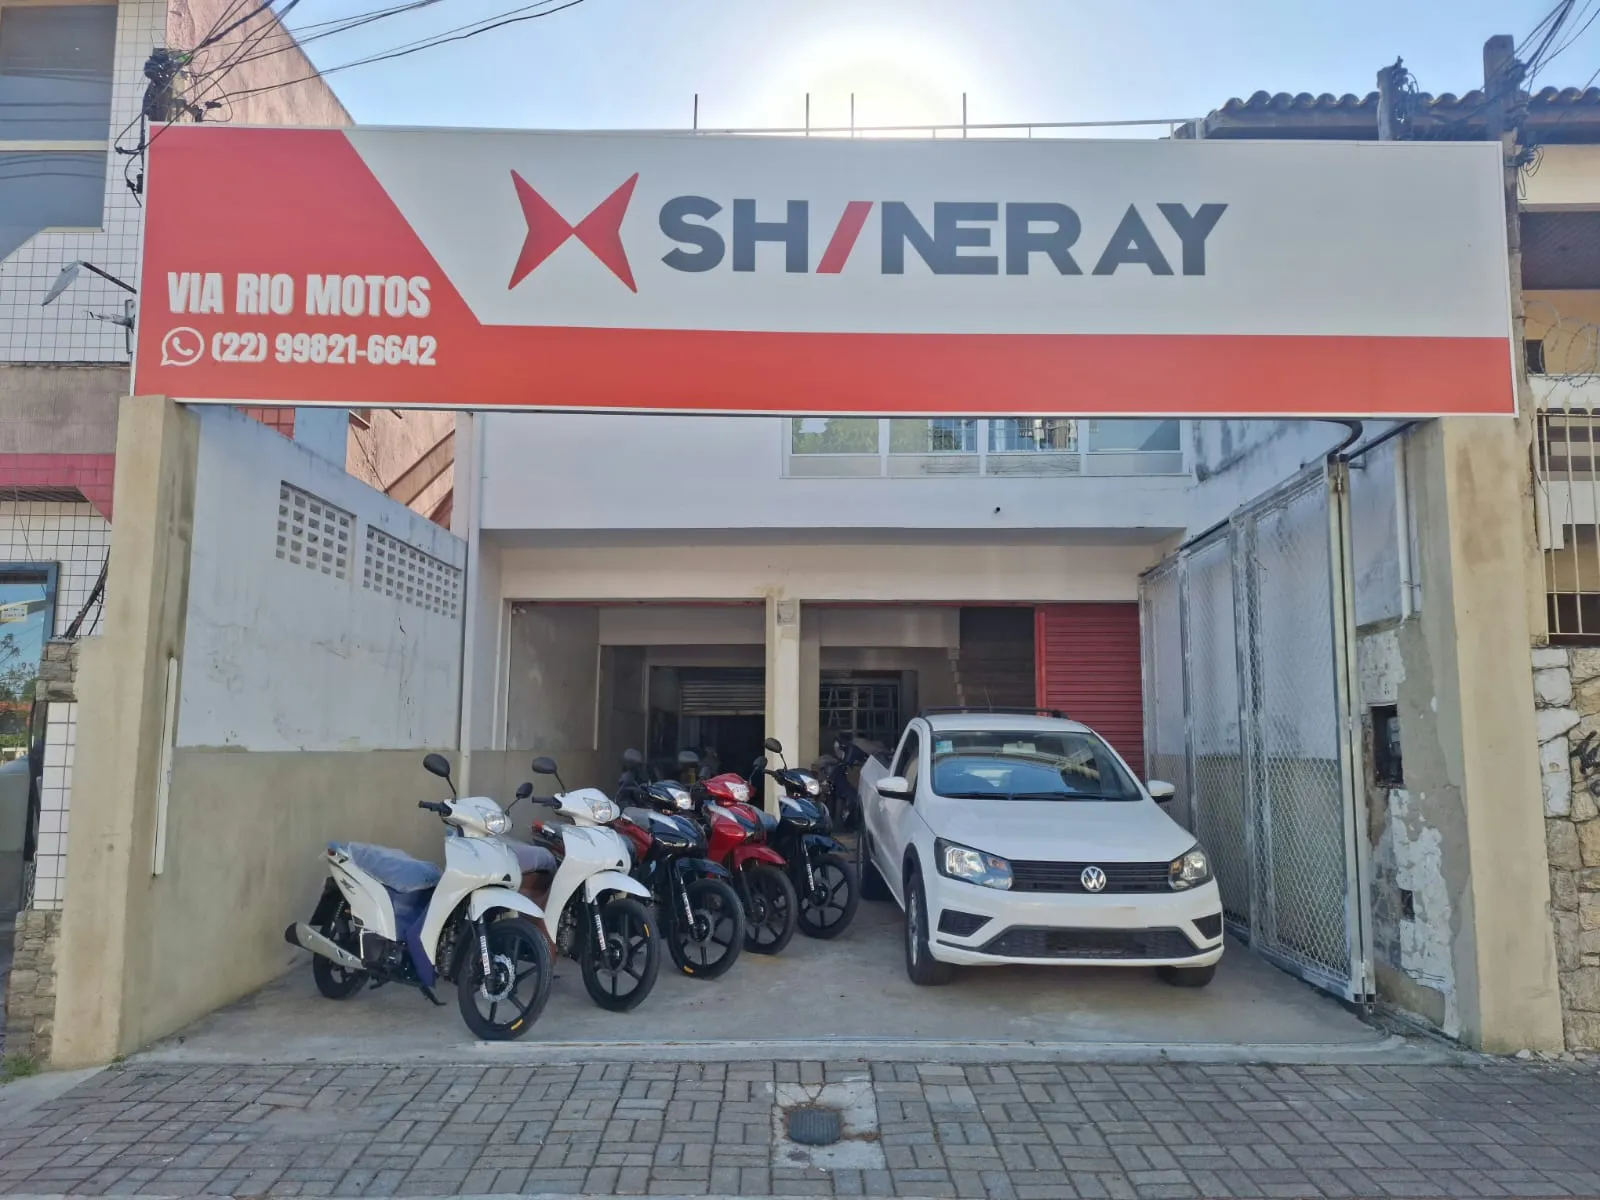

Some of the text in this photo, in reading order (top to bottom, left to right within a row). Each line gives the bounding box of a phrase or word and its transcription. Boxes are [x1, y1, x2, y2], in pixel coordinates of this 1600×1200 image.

[659, 195, 1229, 276] SHINERAY
[167, 271, 432, 319] VIA RIO MOTOS
[211, 331, 437, 367] (22) 99821-6642
